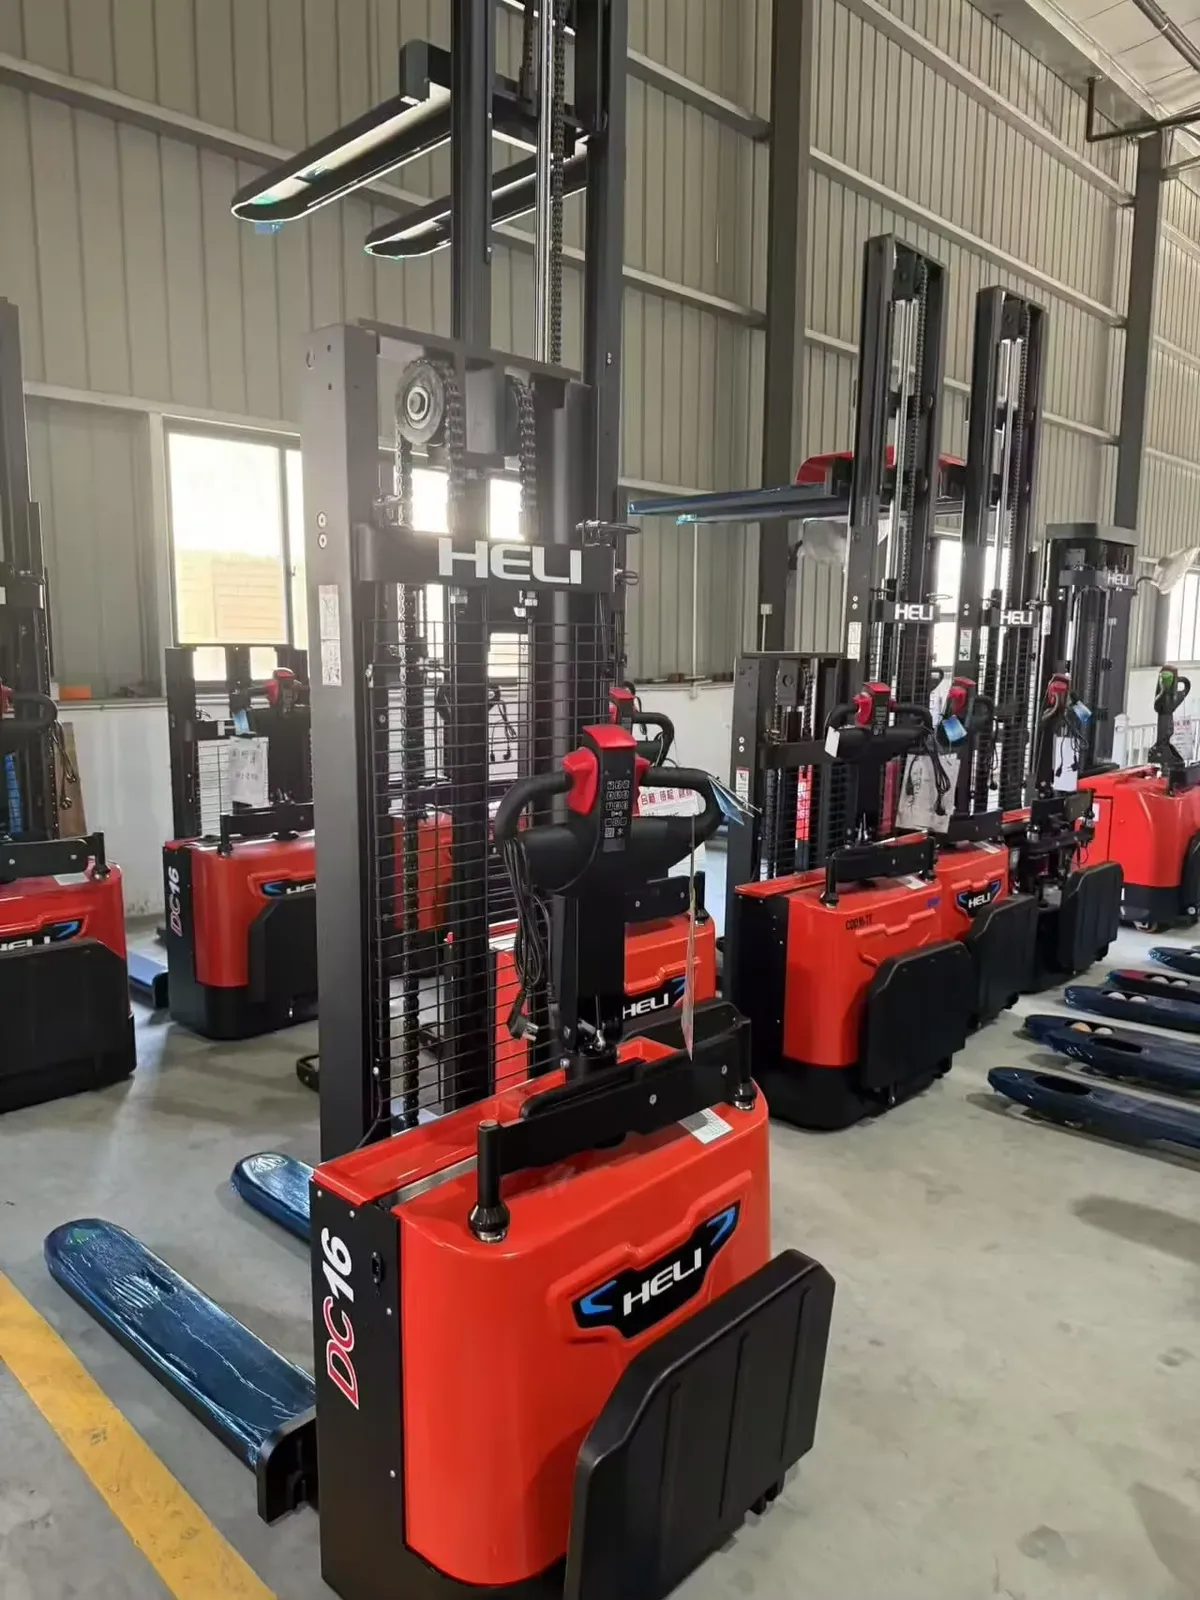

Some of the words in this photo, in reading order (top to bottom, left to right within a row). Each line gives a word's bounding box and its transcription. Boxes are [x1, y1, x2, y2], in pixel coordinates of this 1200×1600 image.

[438, 537, 583, 585] HELI
[1107, 572, 1129, 586] HELI
[894, 603, 934, 621] HELI
[999, 610, 1033, 625] HELI
[168, 866, 182, 937] DC16
[968, 892, 991, 909] HELI
[622, 992, 670, 1020] HELI
[622, 1249, 703, 1318] HELI
[320, 1226, 360, 1411] DC16
